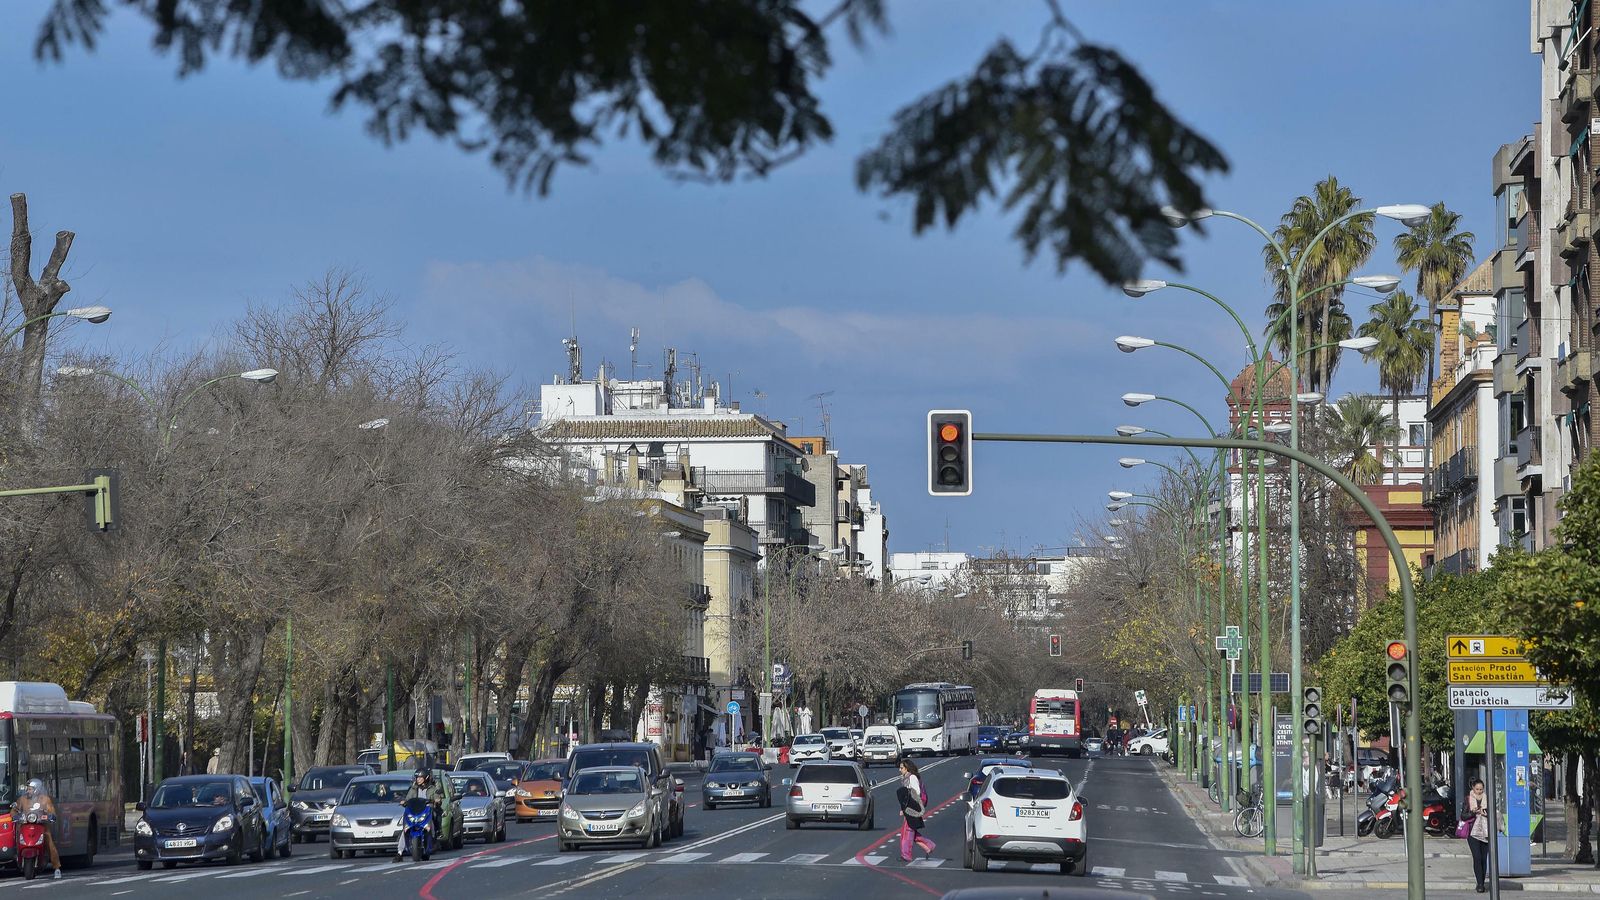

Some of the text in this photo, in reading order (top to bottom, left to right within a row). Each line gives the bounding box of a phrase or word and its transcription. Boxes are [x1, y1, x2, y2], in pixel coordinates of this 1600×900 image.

[1452, 663, 1517, 672] estación Prado
[1452, 672, 1525, 680] San Sebastián
[1452, 688, 1490, 698] palacio
[1453, 696, 1509, 706] de justicia
